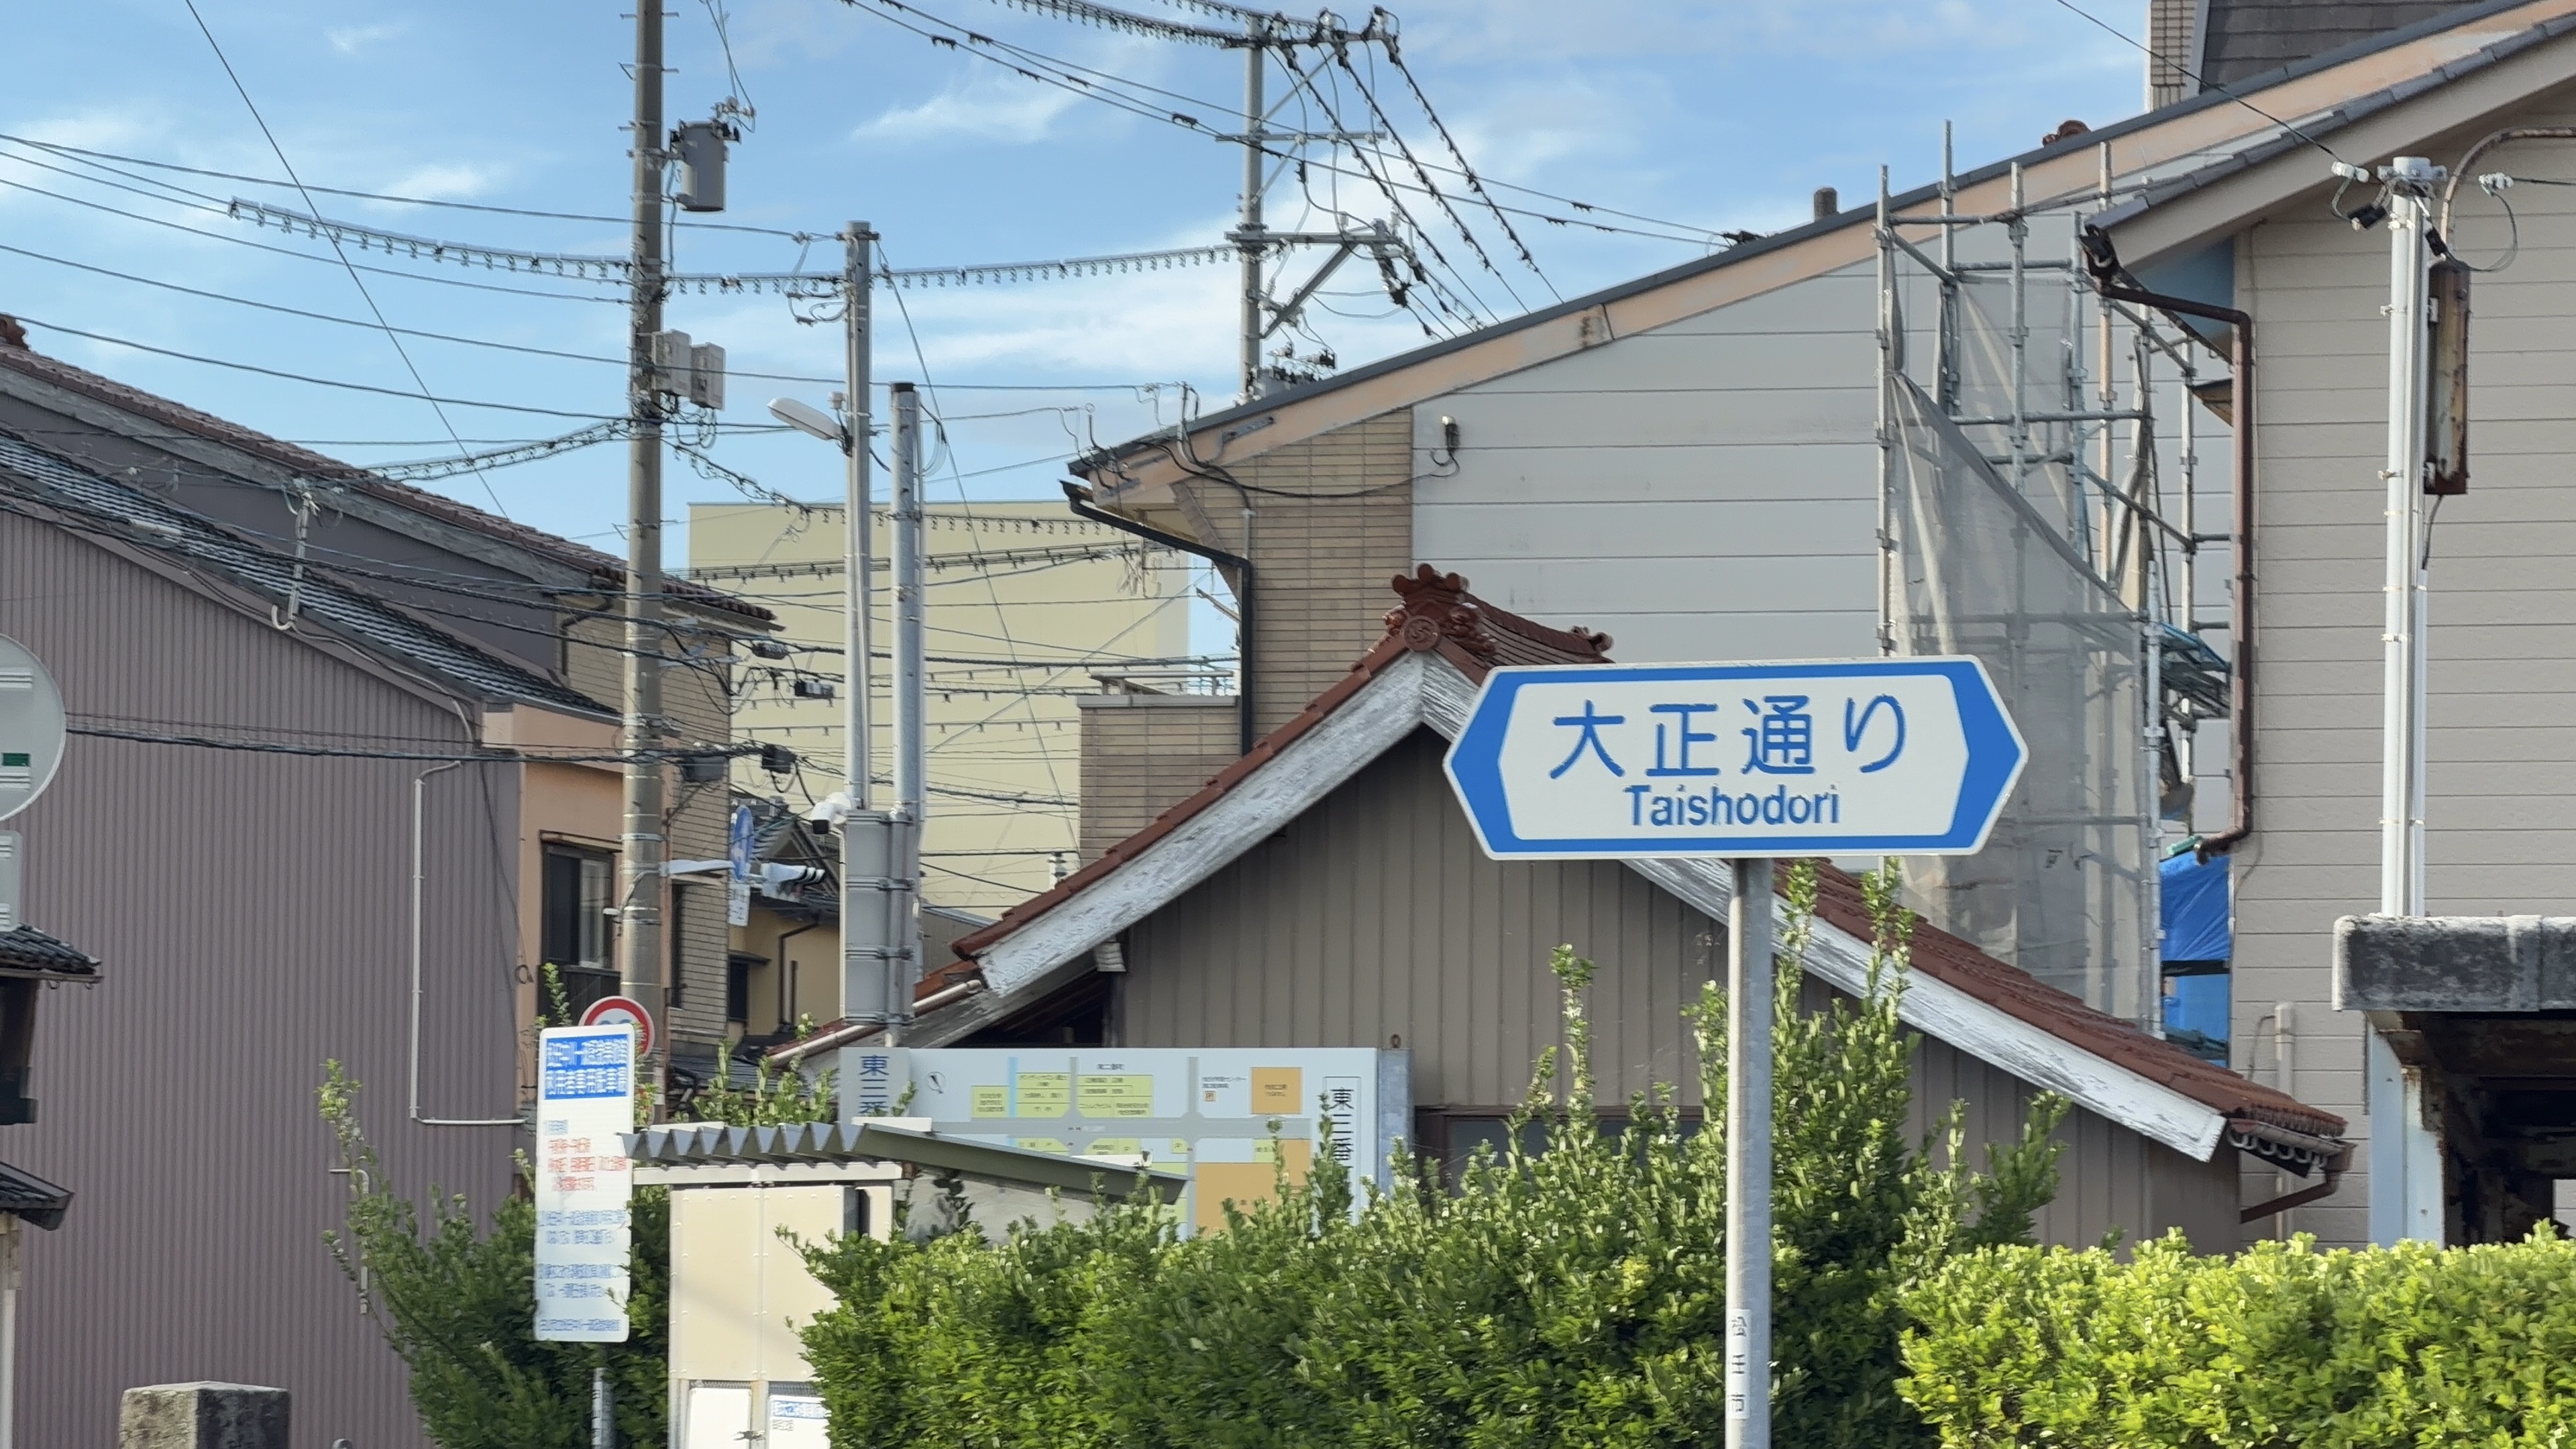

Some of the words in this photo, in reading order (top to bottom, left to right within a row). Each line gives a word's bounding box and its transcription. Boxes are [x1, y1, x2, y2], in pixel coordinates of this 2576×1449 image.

[1549, 692, 1906, 779] 大正通り
[1624, 783, 1840, 827] Taishodori
[1329, 1087, 1354, 1170] 東三番
